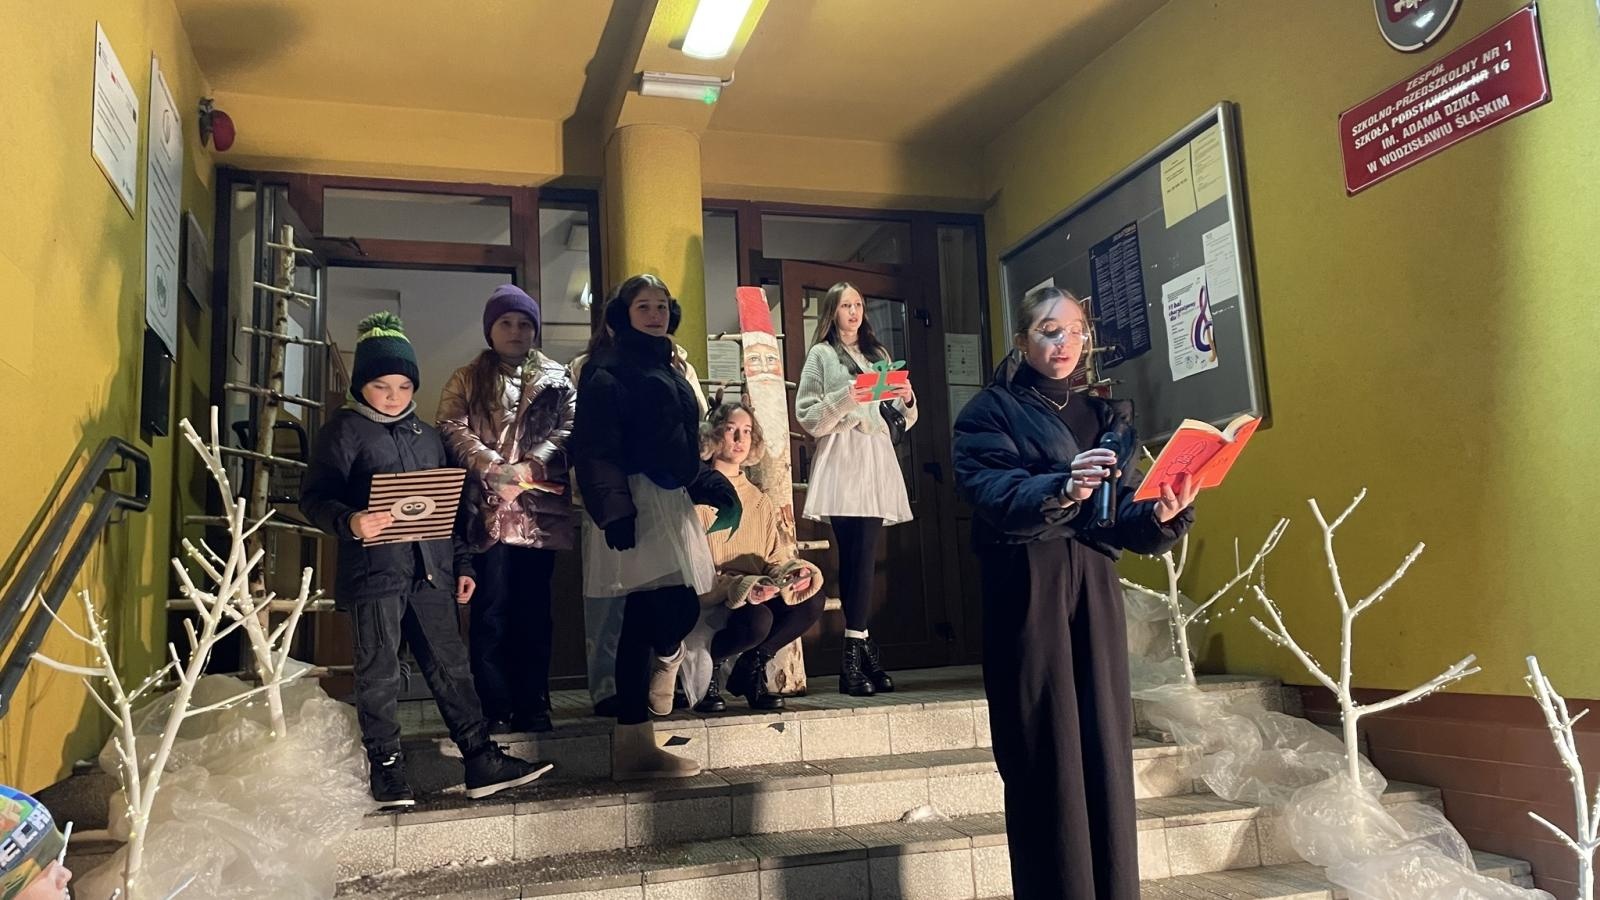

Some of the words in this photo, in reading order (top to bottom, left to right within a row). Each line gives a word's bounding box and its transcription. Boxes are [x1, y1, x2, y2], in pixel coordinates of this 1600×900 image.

[1352, 57, 1478, 137] SZKOLNO-PRZEDSZKOLNY
[1482, 46, 1500, 64] NR
[1504, 40, 1512, 52] 1
[1354, 122, 1389, 150] SZKOŁA
[1391, 80, 1471, 128] PODSTAWOWA
[1471, 69, 1489, 86] NR
[1492, 58, 1510, 74] 16
[1406, 63, 1445, 91] ZESPÓŁ
[1366, 160, 1378, 174] W
[1379, 122, 1453, 167] WODZISŁAWIU
[1455, 94, 1511, 129] ŚLĄSKIM
[1381, 134, 1399, 150] IM.
[1402, 110, 1442, 139] ADAMA
[1443, 90, 1480, 117] DZIKA
